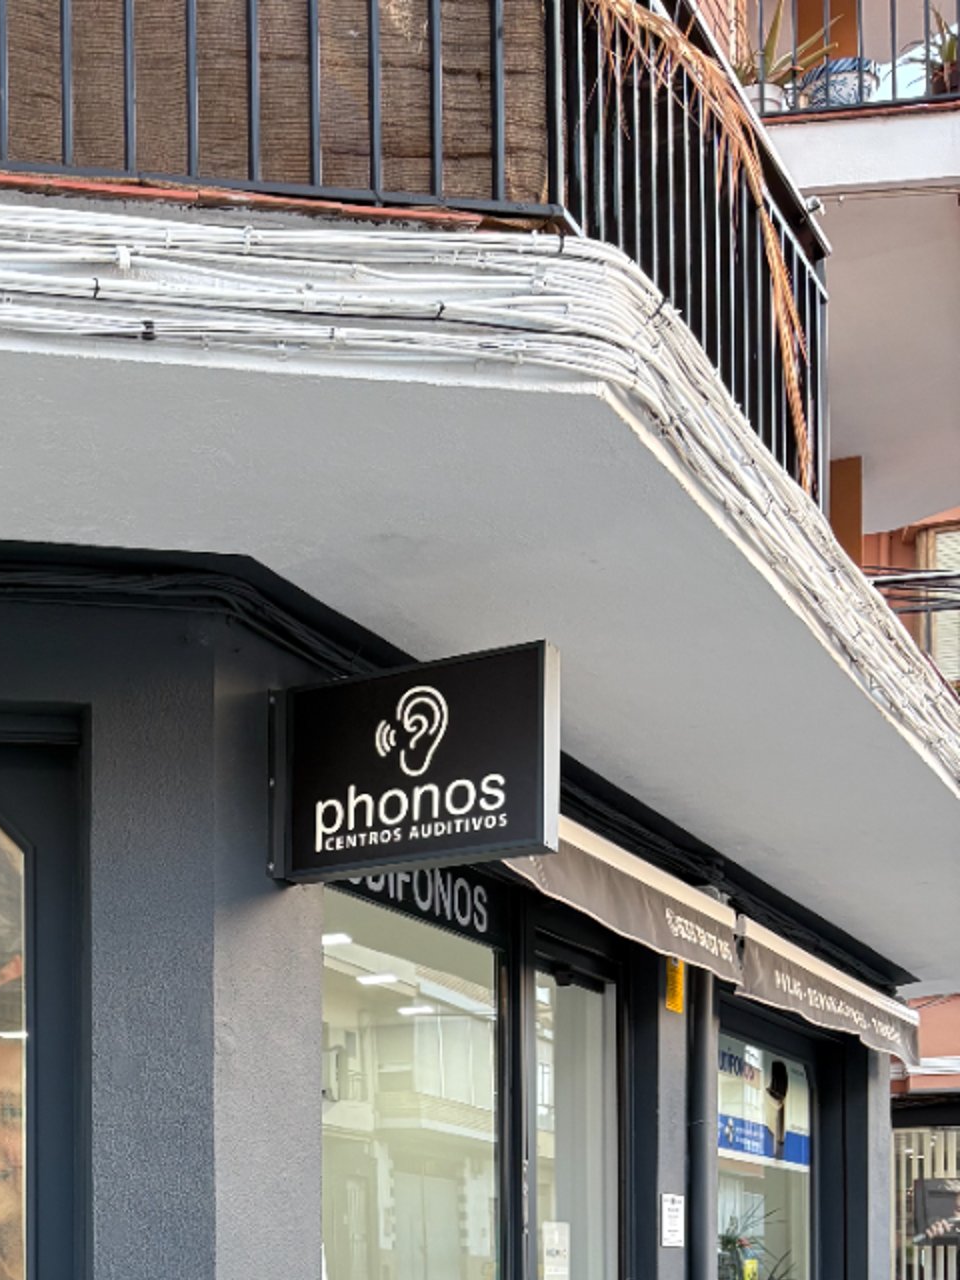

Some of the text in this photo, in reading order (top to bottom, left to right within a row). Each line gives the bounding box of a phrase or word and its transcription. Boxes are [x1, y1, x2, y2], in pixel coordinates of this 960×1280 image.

[315, 773, 507, 853] phonos
[324, 813, 508, 852] CENTROS AUDITIVOS
